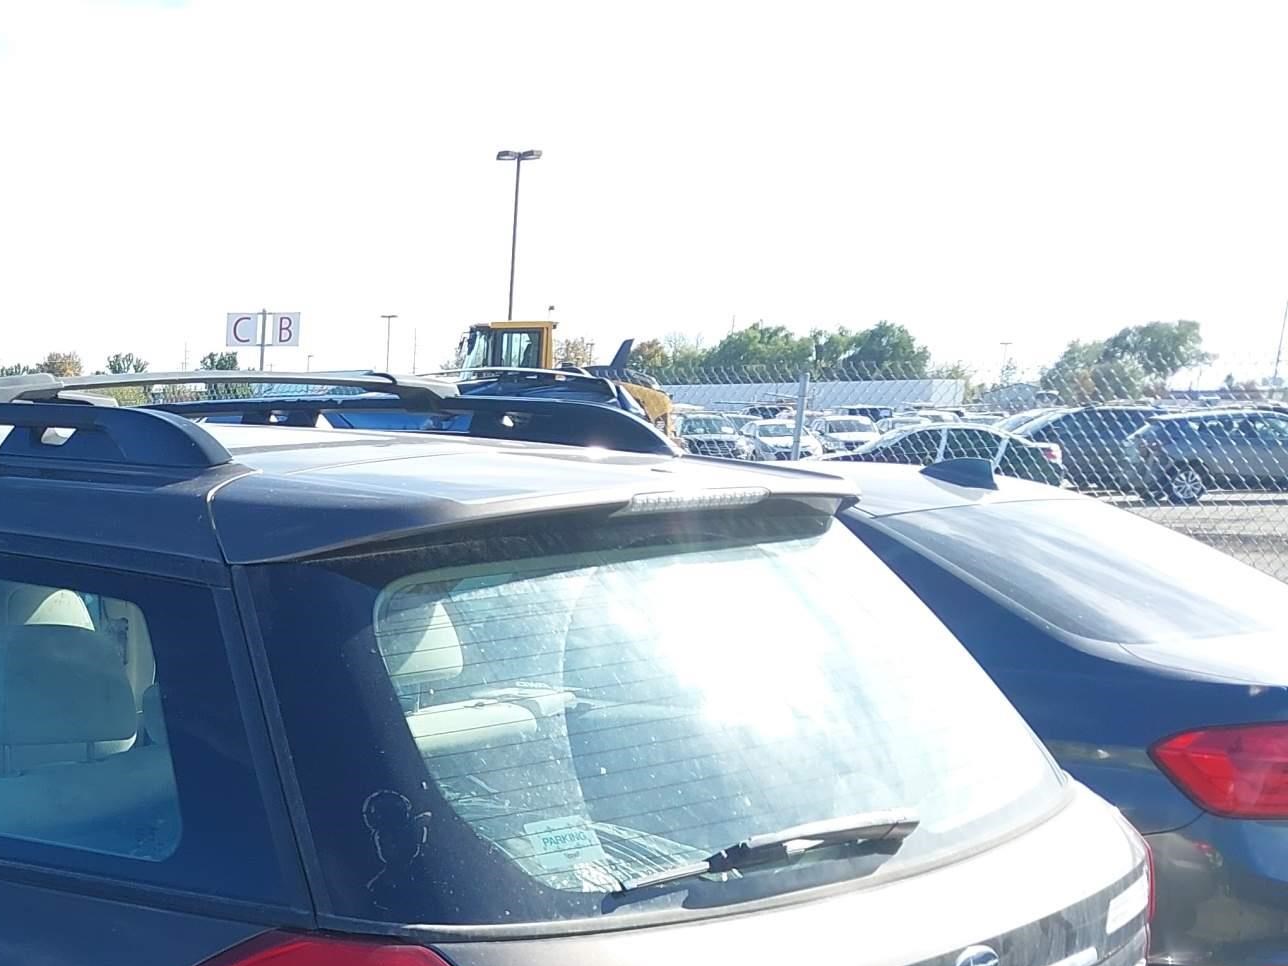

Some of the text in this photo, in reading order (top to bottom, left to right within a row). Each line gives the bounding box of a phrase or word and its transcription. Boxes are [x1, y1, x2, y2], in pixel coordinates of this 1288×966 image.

[233, 316, 292, 343] C B
[541, 831, 587, 847] PARKING
